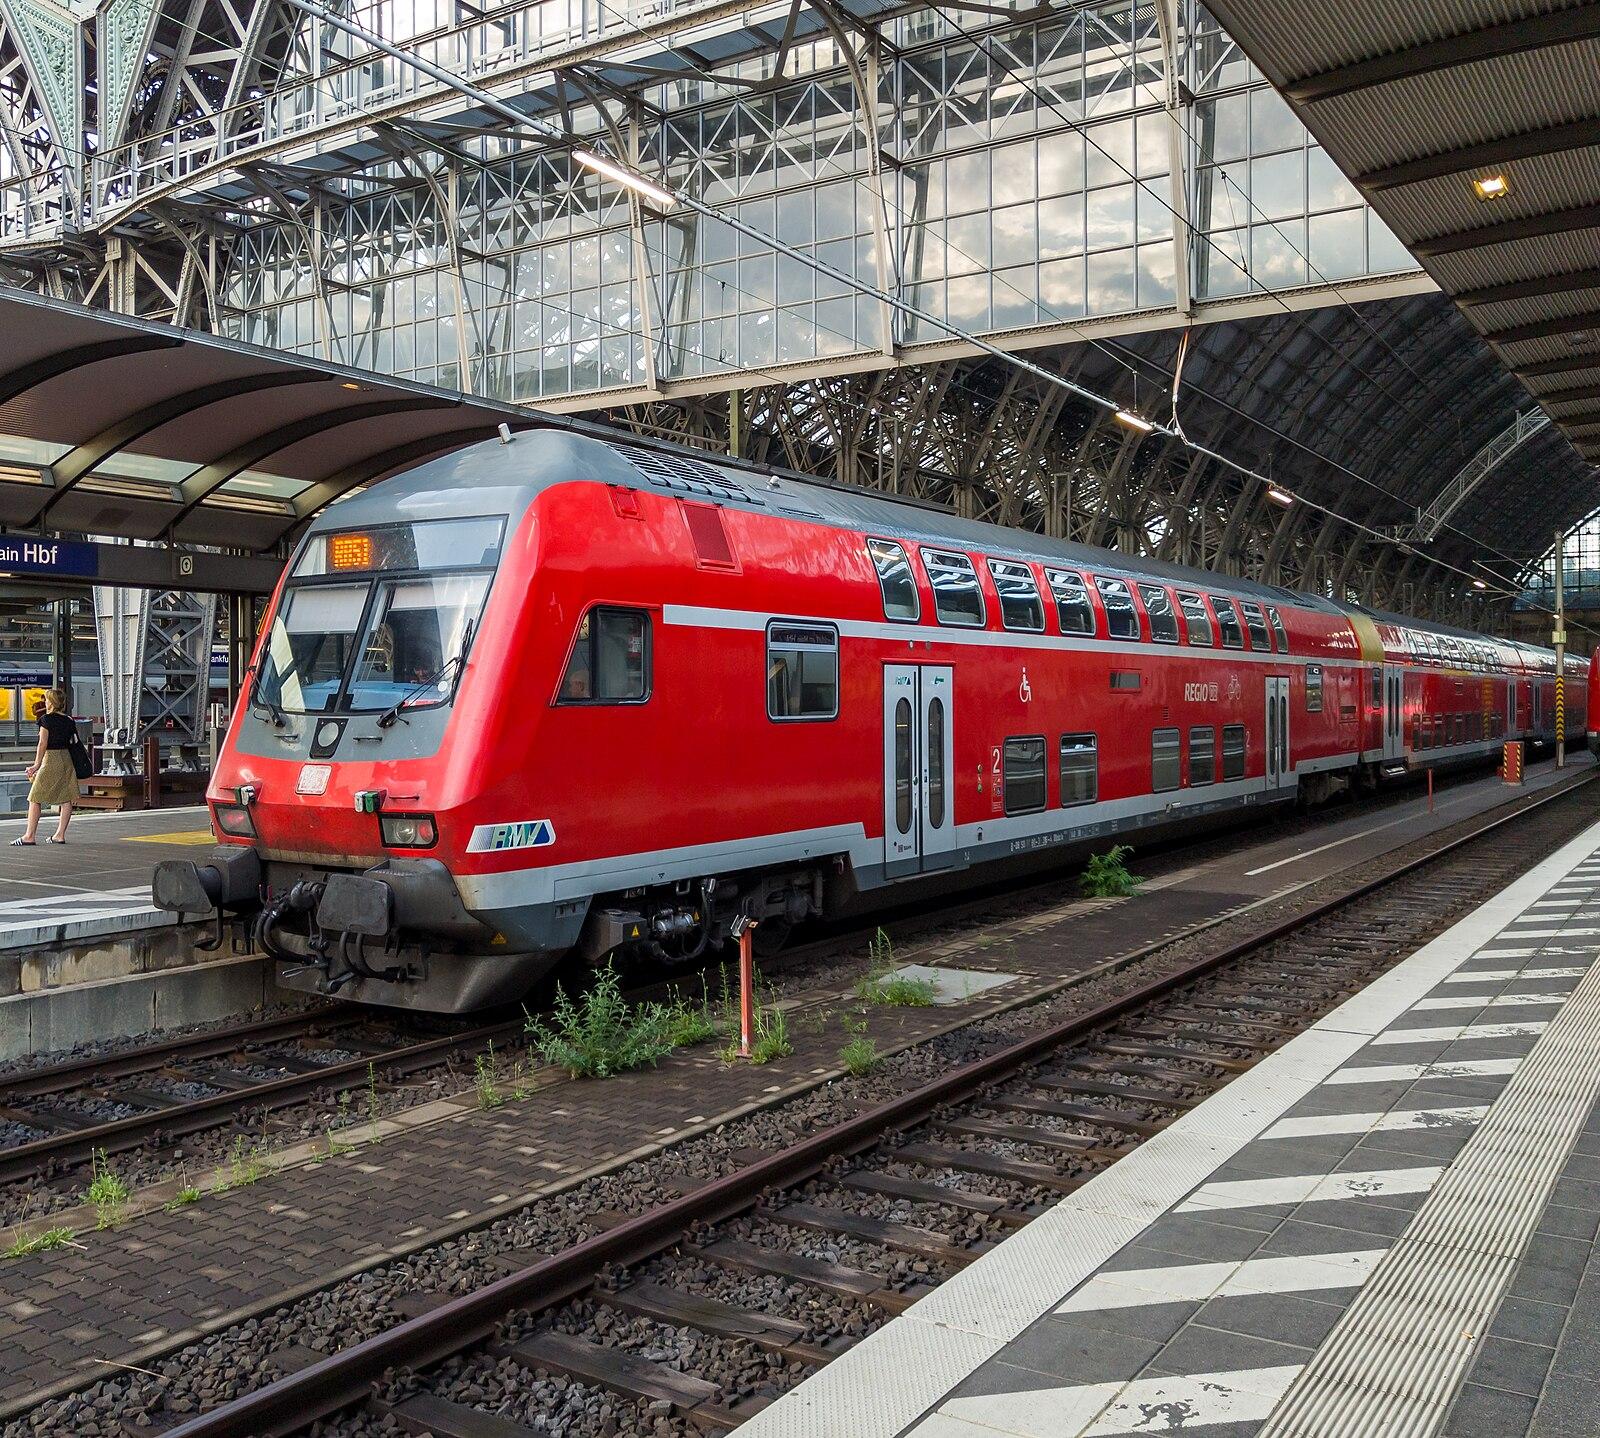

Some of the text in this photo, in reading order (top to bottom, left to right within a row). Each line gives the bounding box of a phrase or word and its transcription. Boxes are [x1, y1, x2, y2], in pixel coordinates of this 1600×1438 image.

[0, 543, 58, 565] ain Hbf
[90, 688, 96, 697] 2
[1184, 682, 1208, 702] REGIO
[992, 747, 1001, 774] 2
[489, 821, 545, 851] RMV
